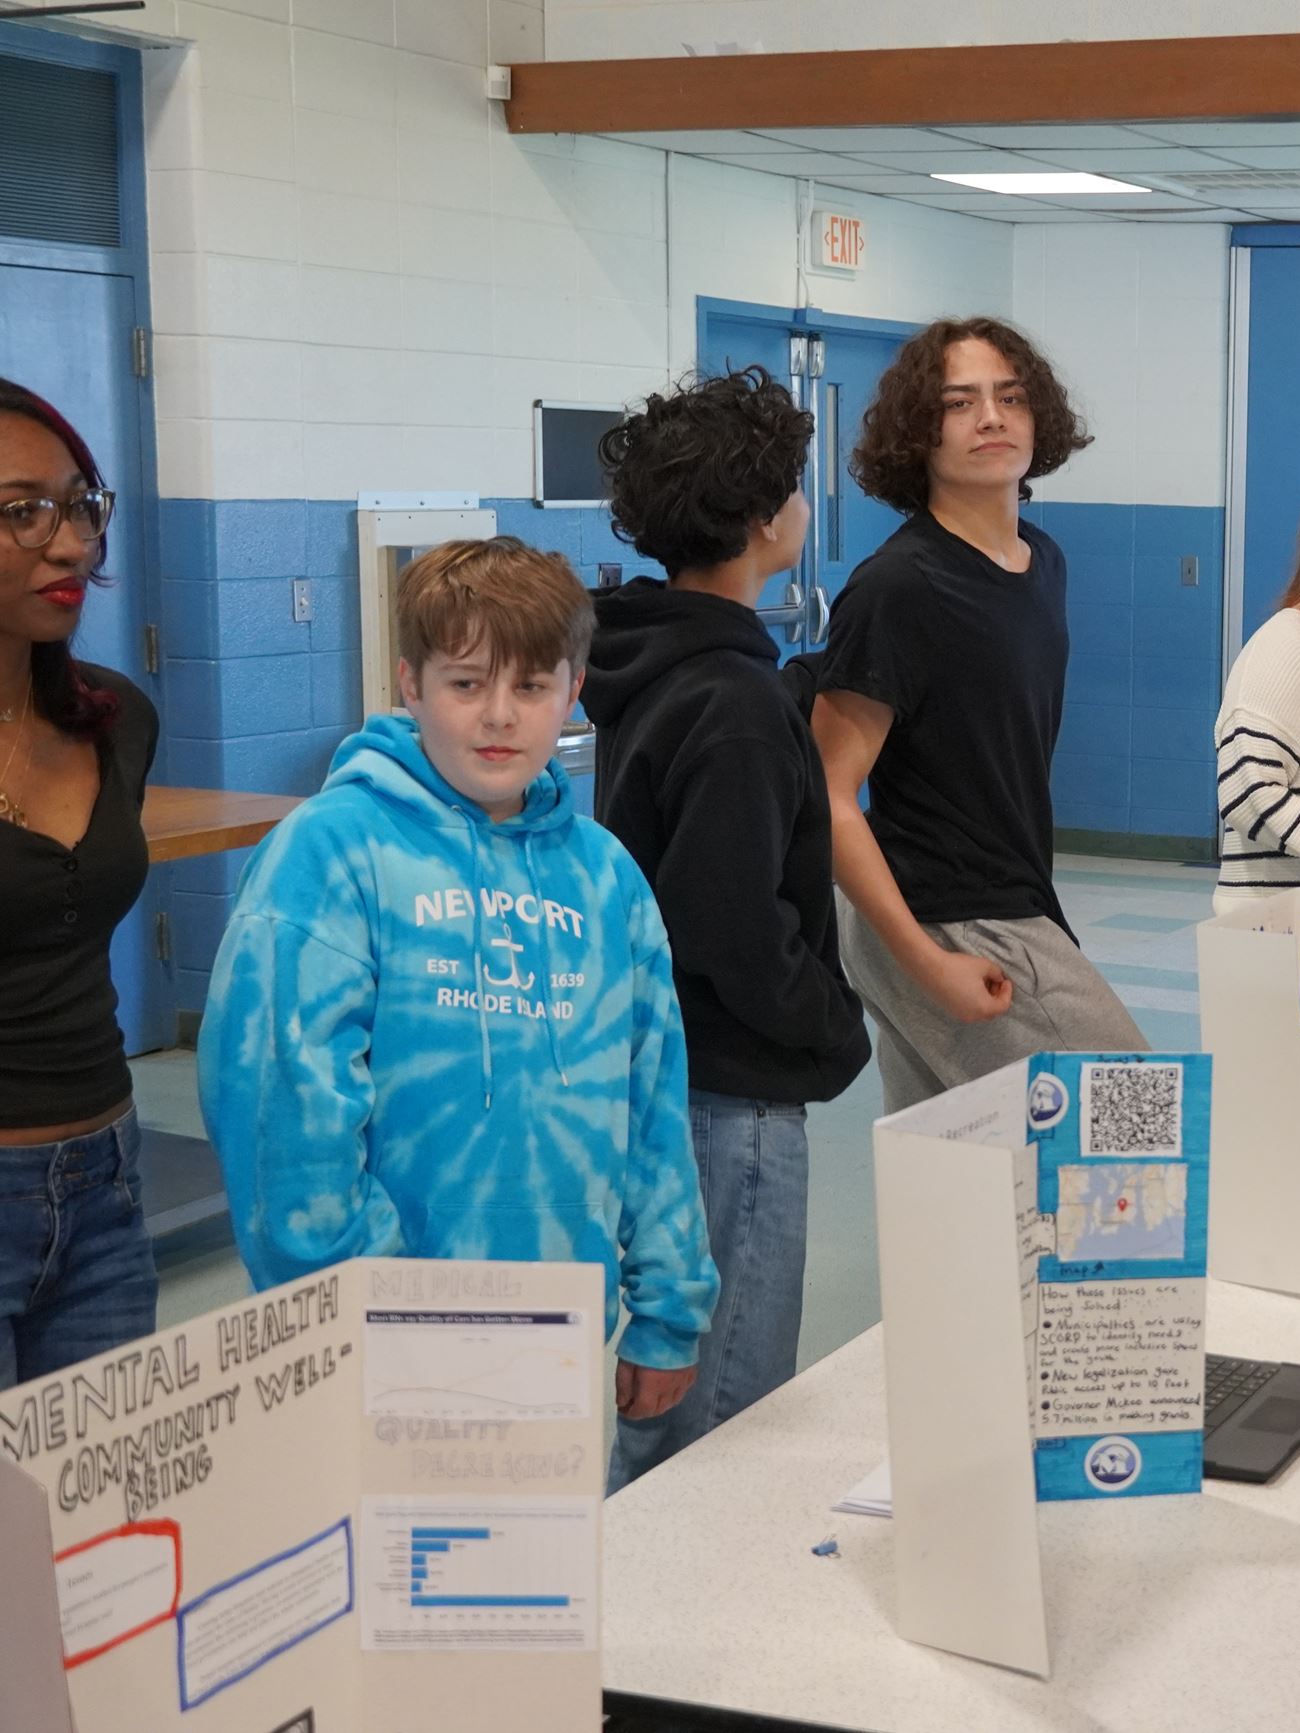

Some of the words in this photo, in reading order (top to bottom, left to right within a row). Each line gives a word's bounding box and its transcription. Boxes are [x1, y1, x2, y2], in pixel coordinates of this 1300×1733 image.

[831, 216, 860, 266] EXIT
[415, 887, 584, 939] NEWPORT
[427, 959, 459, 975] EST
[551, 972, 585, 988] 1639
[371, 1267, 522, 1302] MEDICAL
[0, 1334, 200, 1462] MENTAL
[217, 1275, 339, 1373] HEALTH
[1053, 1369, 1078, 1382] New
[58, 1384, 241, 1513] COMMUNITY
[256, 1342, 353, 1412] WELL-
[375, 1416, 512, 1446] QUALITY
[125, 1443, 213, 1524] BEING
